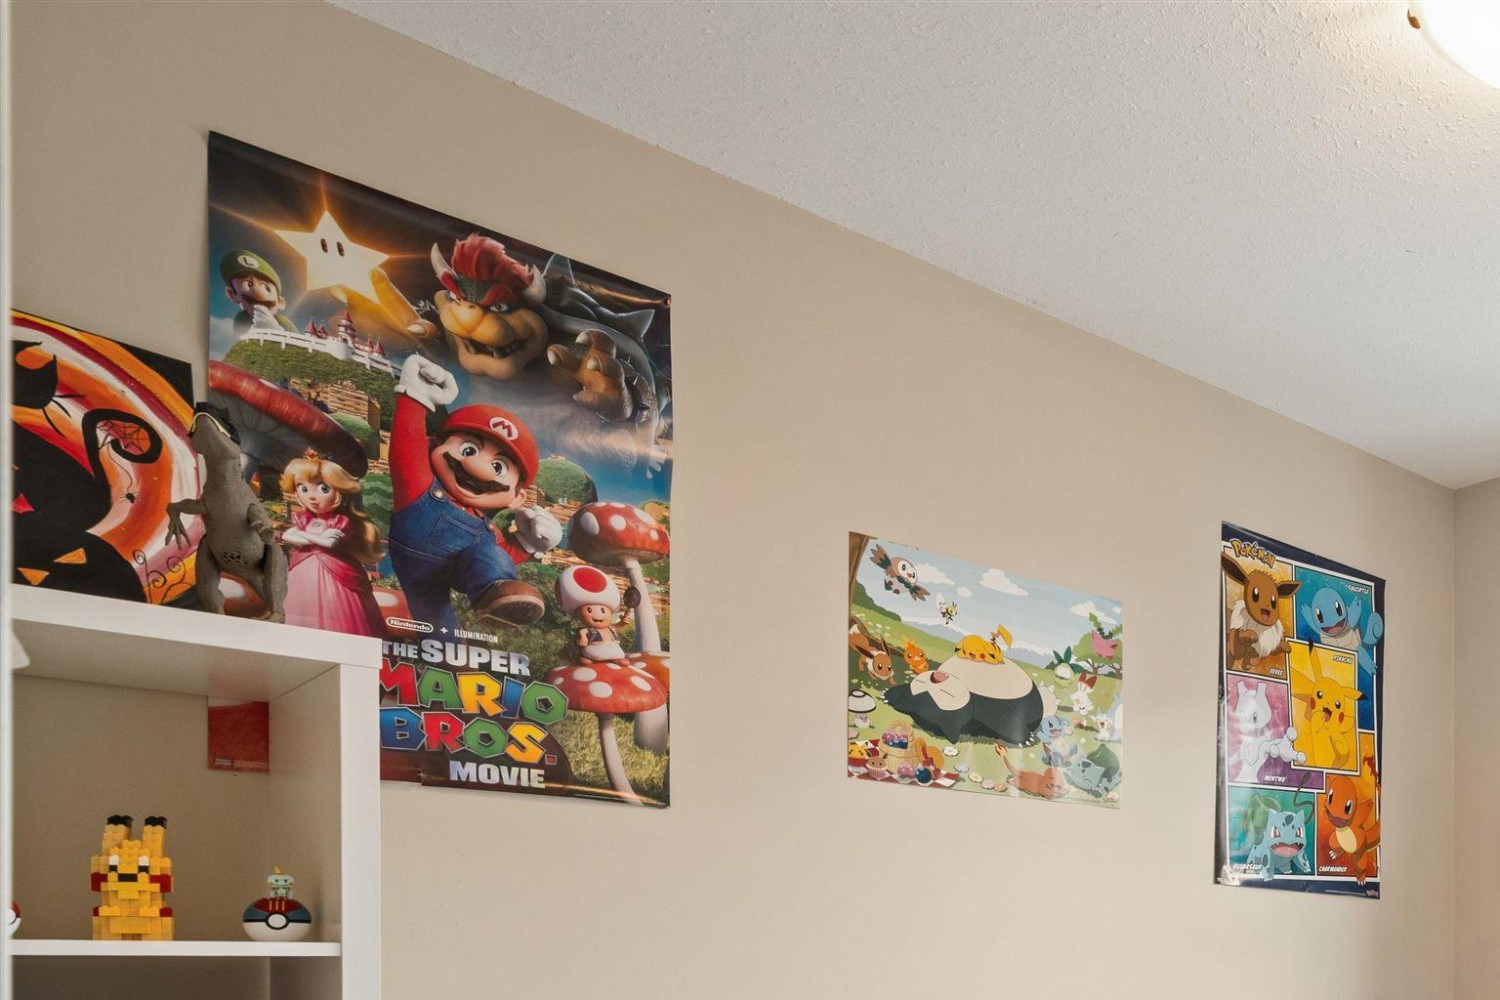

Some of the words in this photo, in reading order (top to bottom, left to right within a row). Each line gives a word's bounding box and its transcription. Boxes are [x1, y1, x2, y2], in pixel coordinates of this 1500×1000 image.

[492, 421, 512, 438] M
[387, 617, 433, 633] Nintendo
[454, 629, 498, 643] ILLUMINATION
[382, 641, 418, 659] THE
[421, 639, 531, 676] SUPER
[379, 658, 569, 725] MARIO
[379, 706, 557, 765] BROS.
[450, 761, 546, 788] MOVIE
[1319, 865, 1347, 873] CHARMANDER
